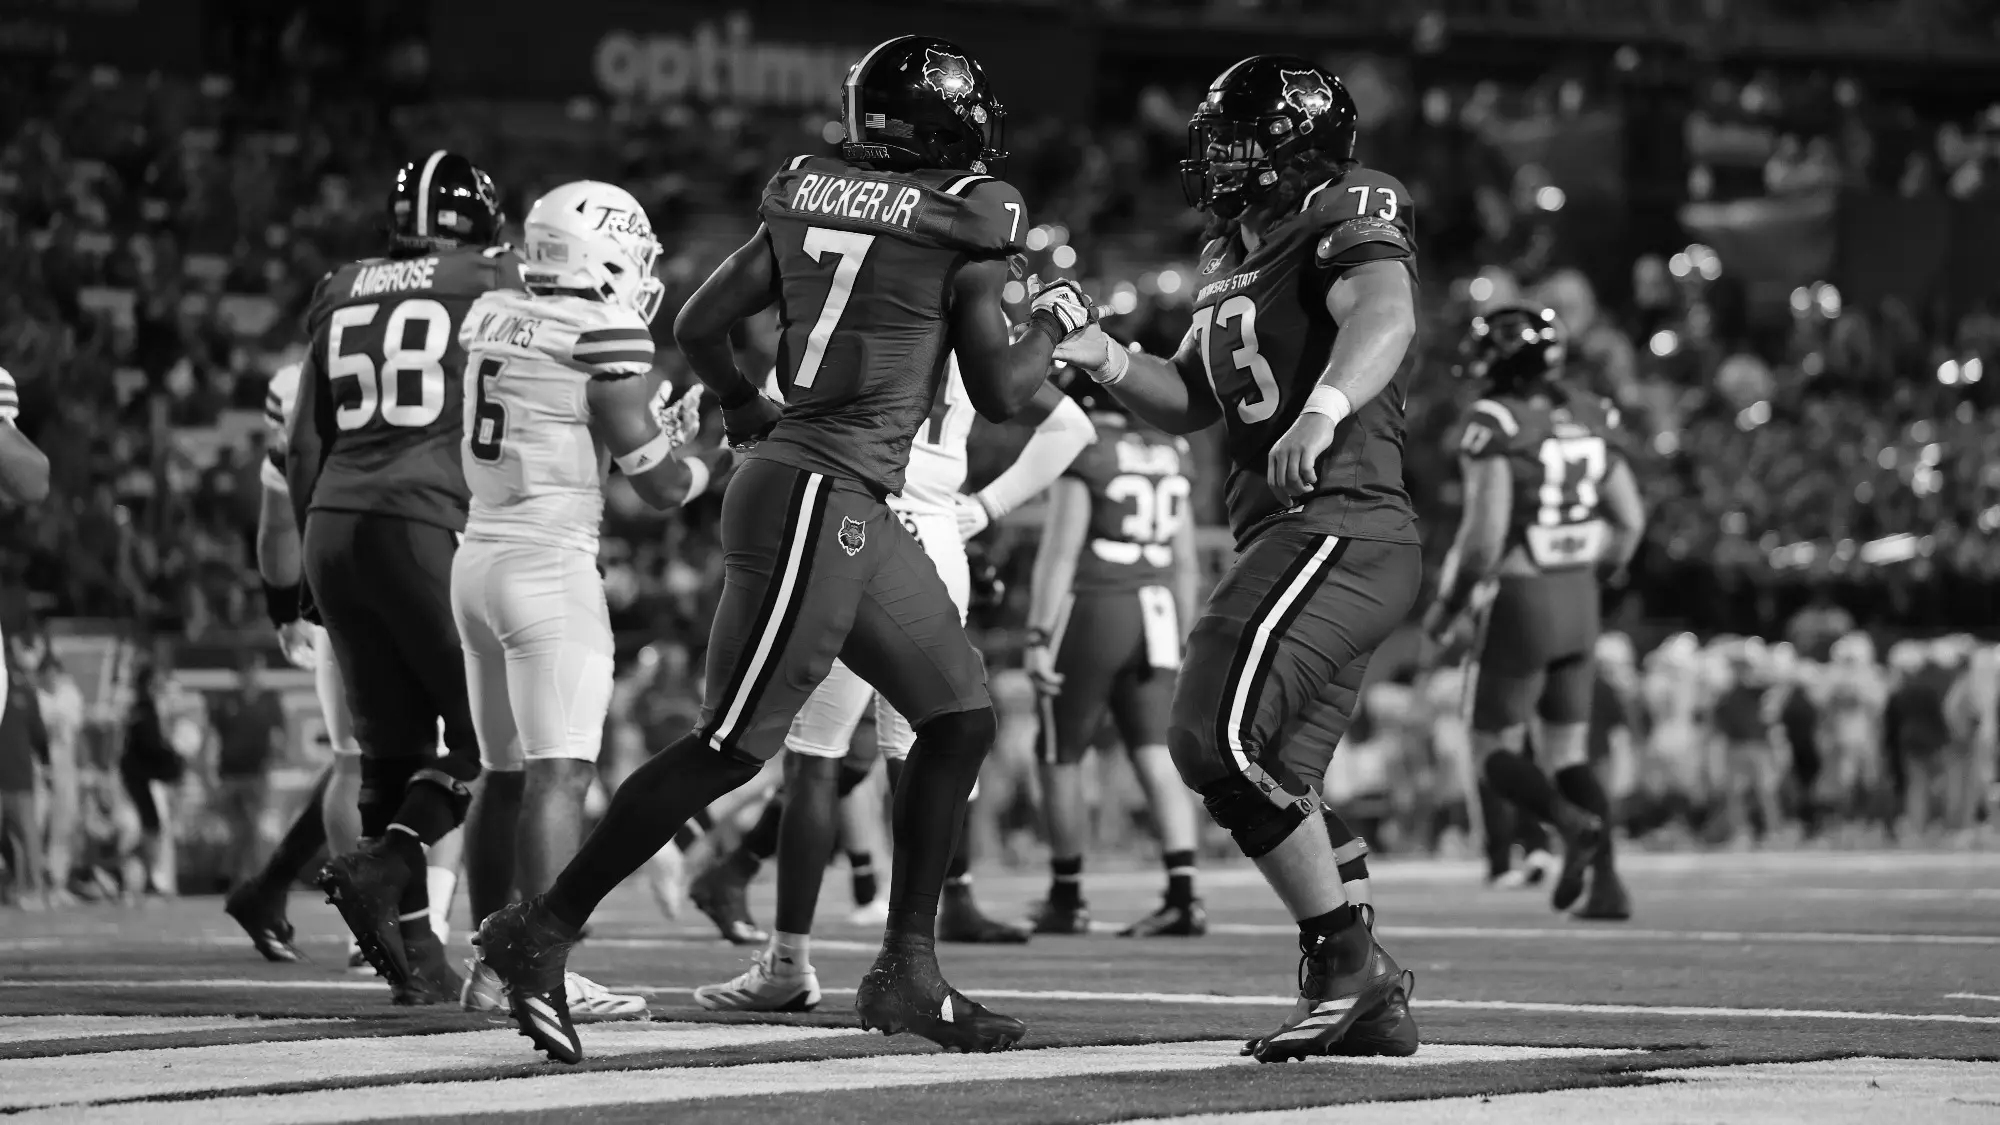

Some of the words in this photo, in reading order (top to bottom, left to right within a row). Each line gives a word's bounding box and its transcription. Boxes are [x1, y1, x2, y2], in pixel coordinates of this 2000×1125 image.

[594, 20, 848, 106] optimu
[791, 173, 889, 219] RUCKER
[881, 186, 921, 228] JR
[1003, 202, 1021, 243] 7
[1347, 185, 1398, 222] 73
[350, 257, 439, 299] AMBROSE
[793, 226, 876, 389] 7
[1231, 269, 1261, 291] STATE
[327, 298, 452, 431] 58
[1192, 295, 1280, 430] 73
[470, 357, 507, 463] 6
[1537, 436, 1607, 527] 17
